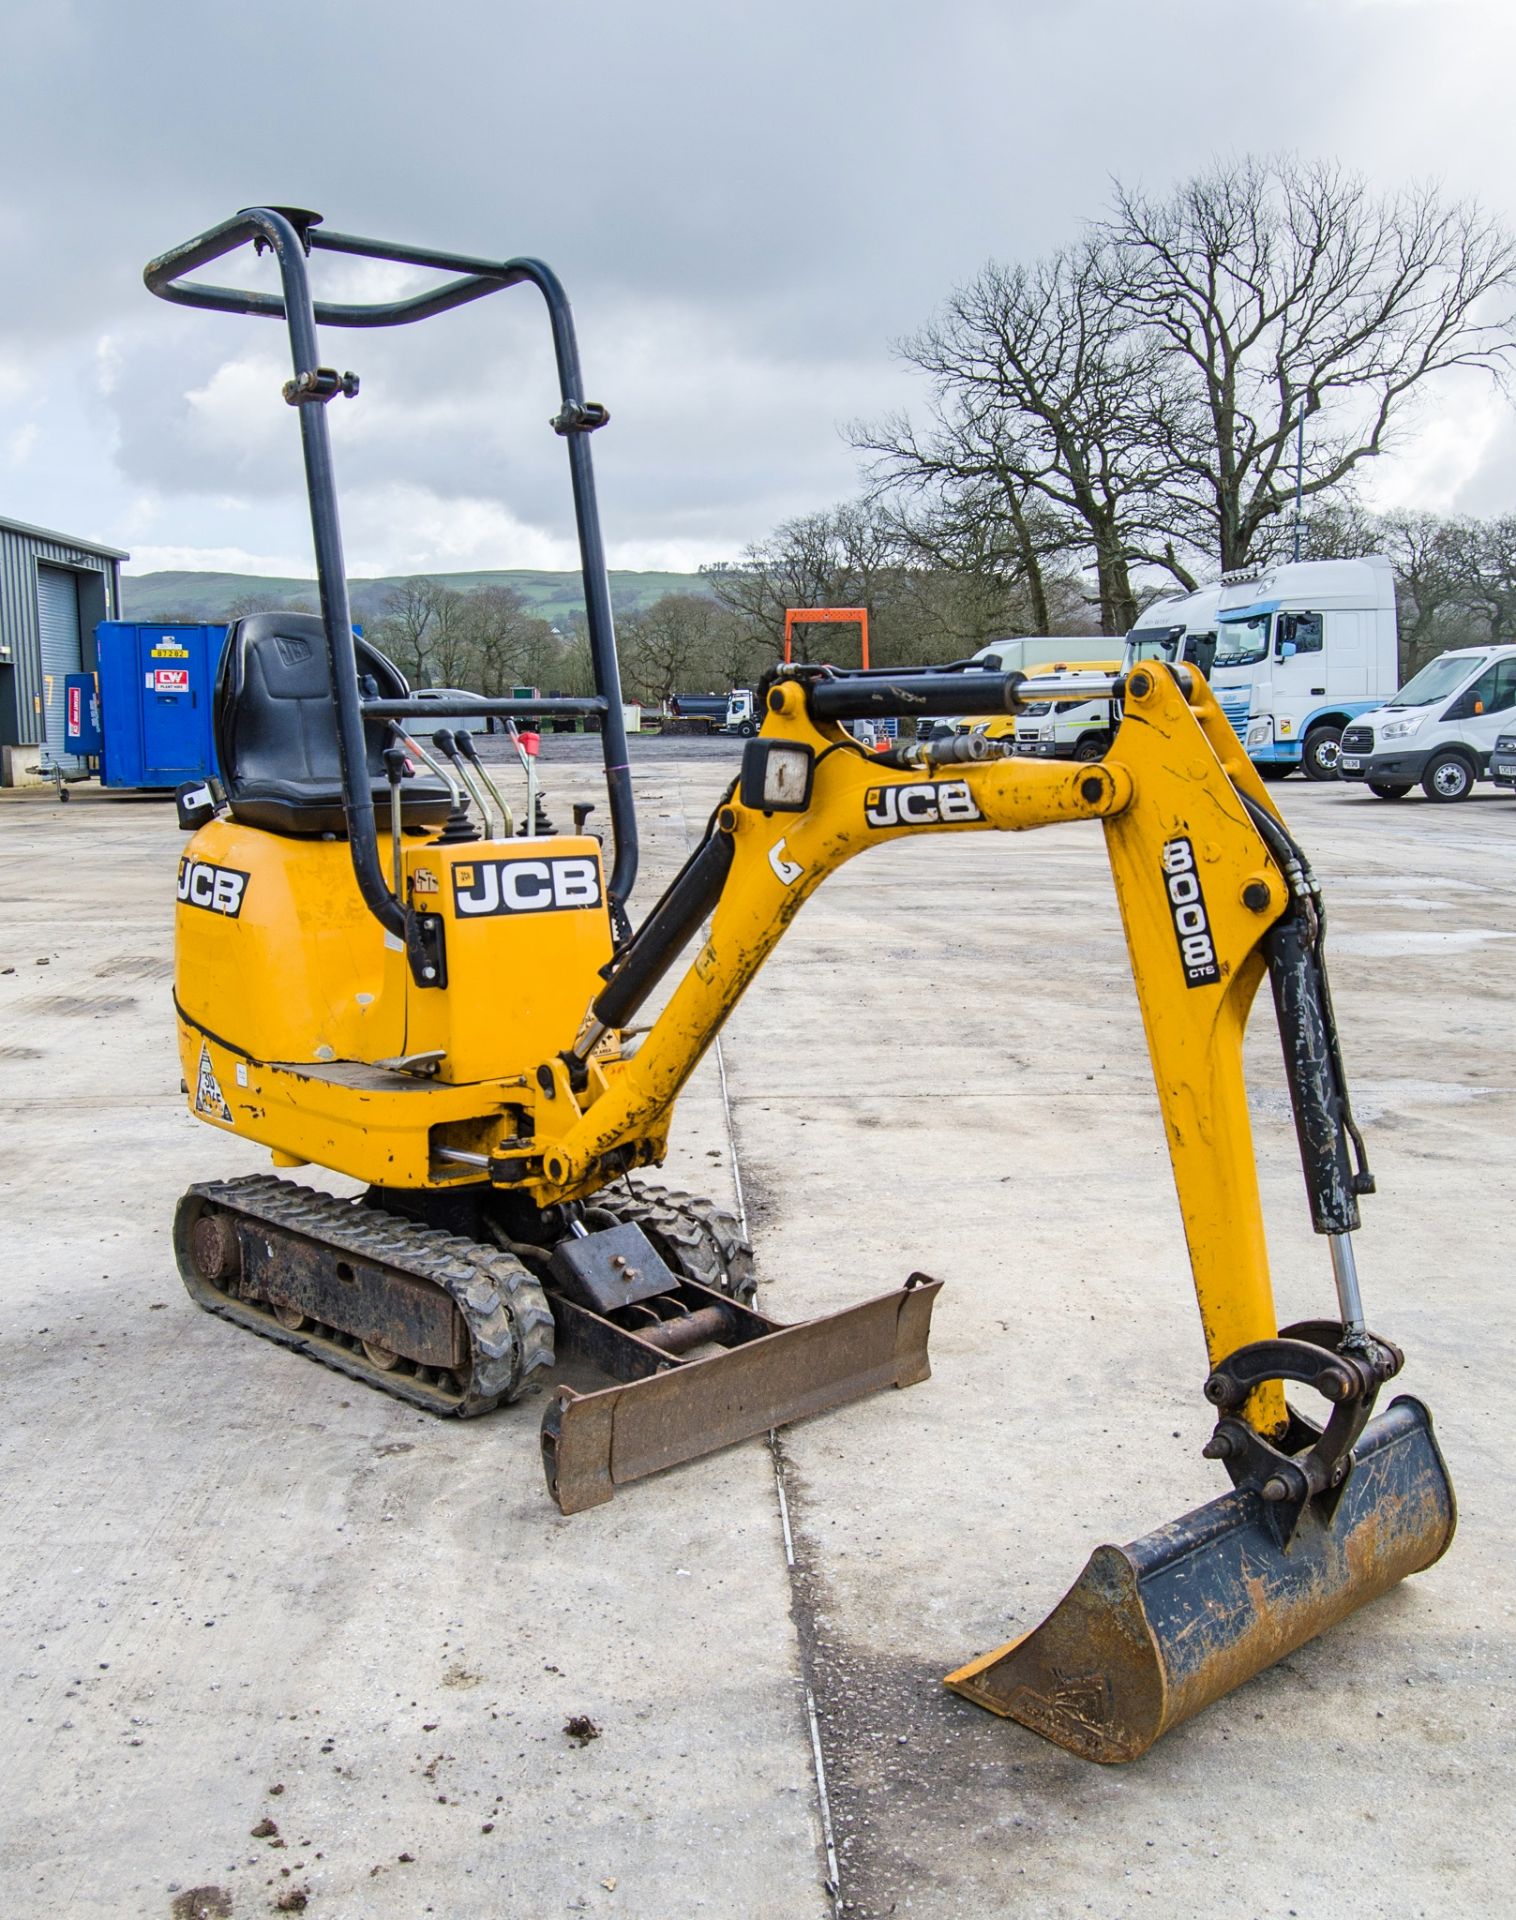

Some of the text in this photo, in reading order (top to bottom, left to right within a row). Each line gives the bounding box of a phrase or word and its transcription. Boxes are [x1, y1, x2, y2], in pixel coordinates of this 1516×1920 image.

[866, 783, 981, 826] JCB
[177, 862, 245, 913] JCB
[457, 859, 600, 914] JCB
[1163, 841, 1214, 967] 8008
[1189, 965, 1216, 979] CTS
